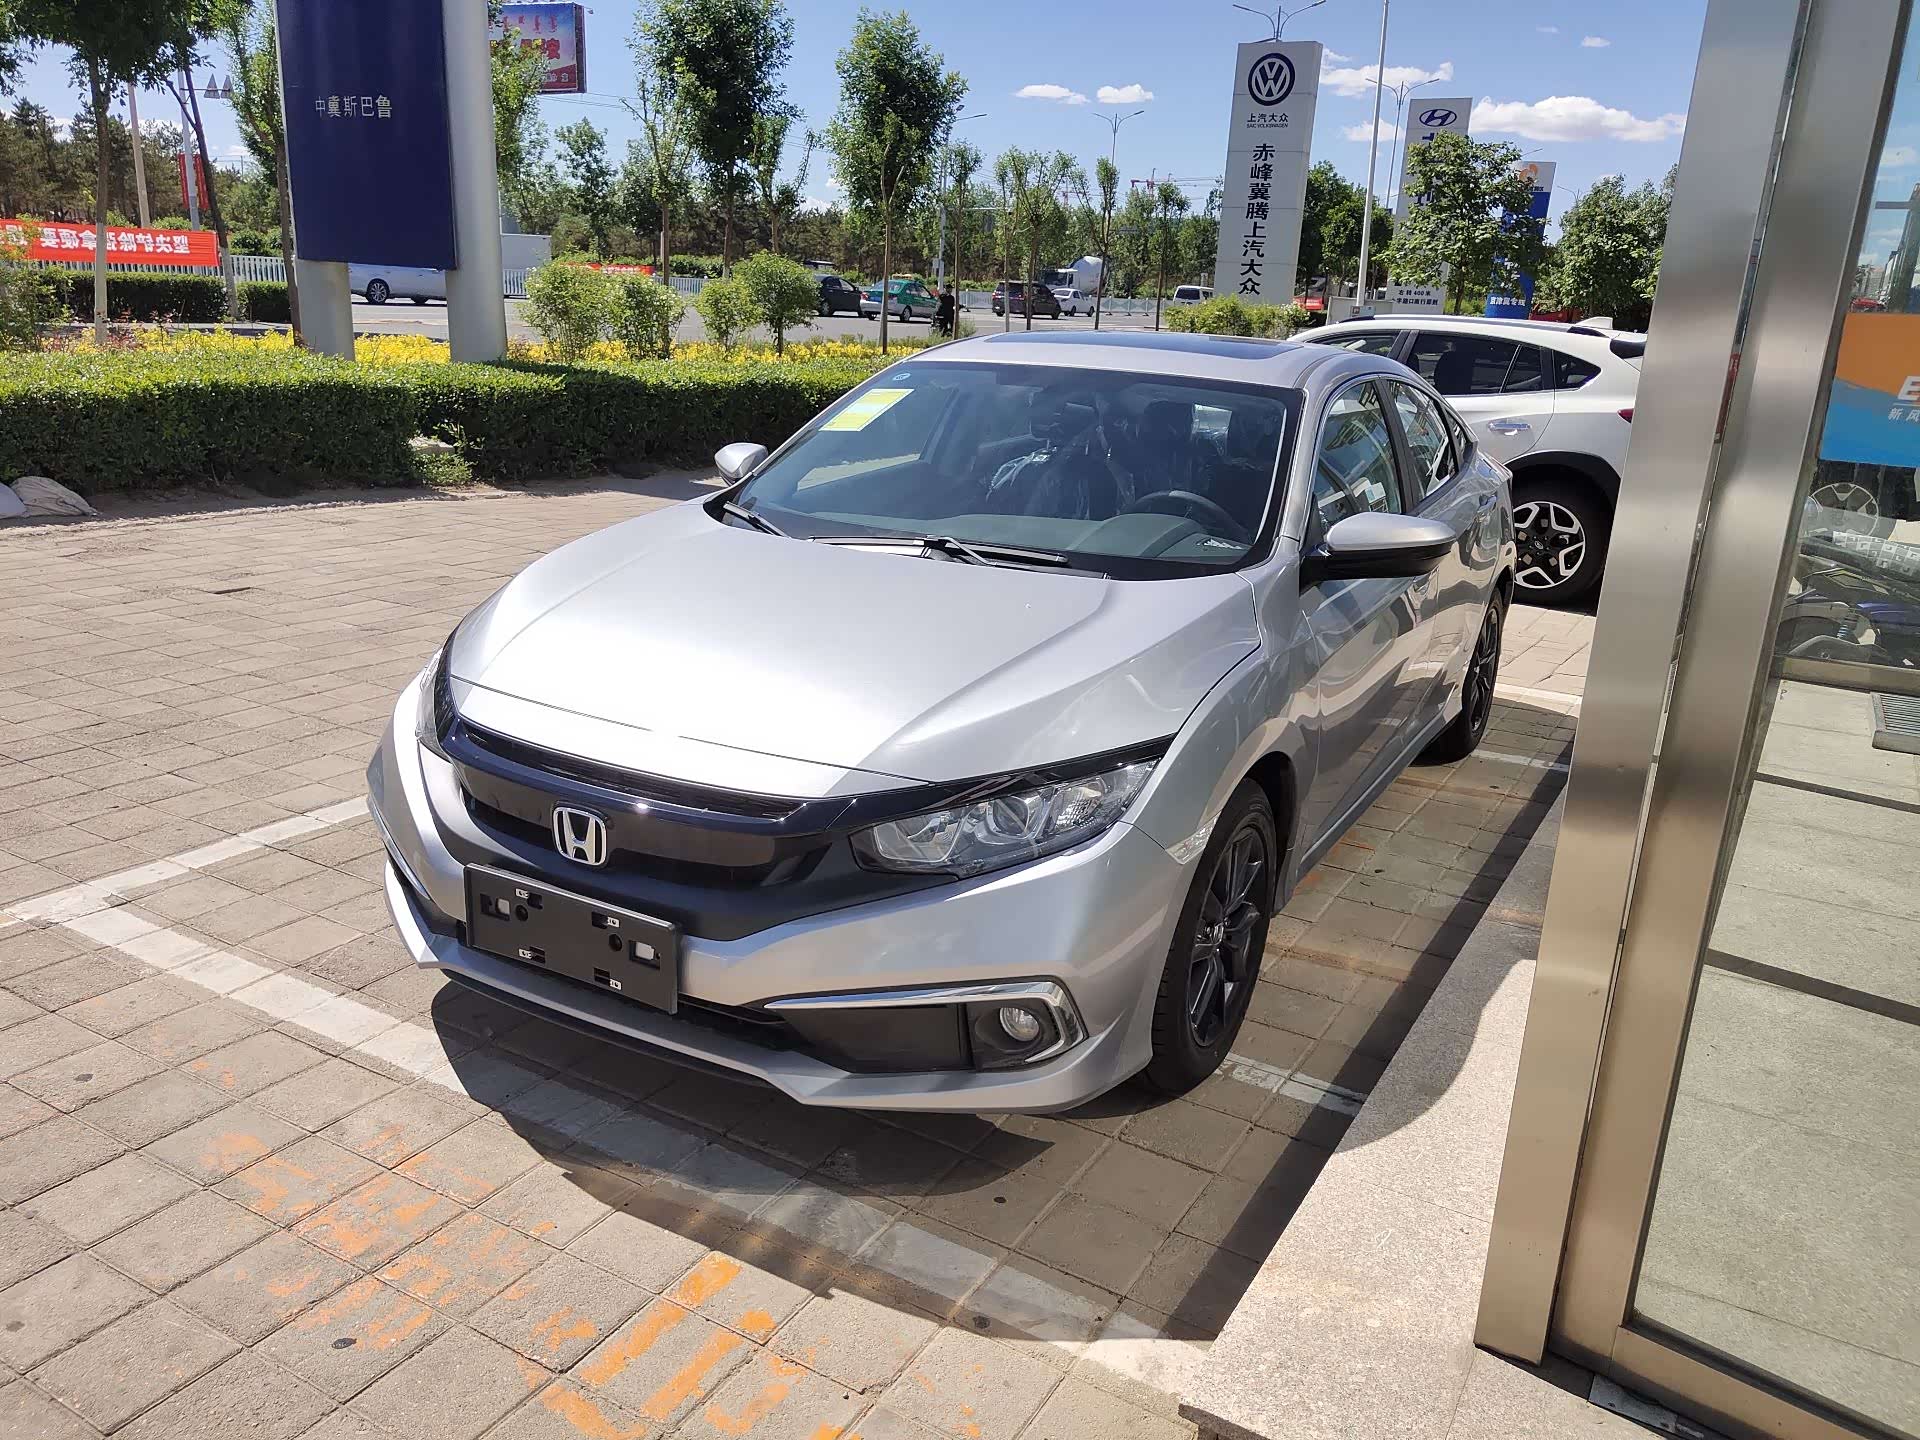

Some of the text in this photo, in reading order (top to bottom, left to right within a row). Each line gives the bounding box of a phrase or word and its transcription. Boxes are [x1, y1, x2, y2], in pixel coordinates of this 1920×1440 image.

[315, 95, 393, 118] 中冀斯巴鲁
[1247, 112, 1289, 123] 上汽大众
[1239, 143, 1275, 295] 赤峰冀腾上汽大众
